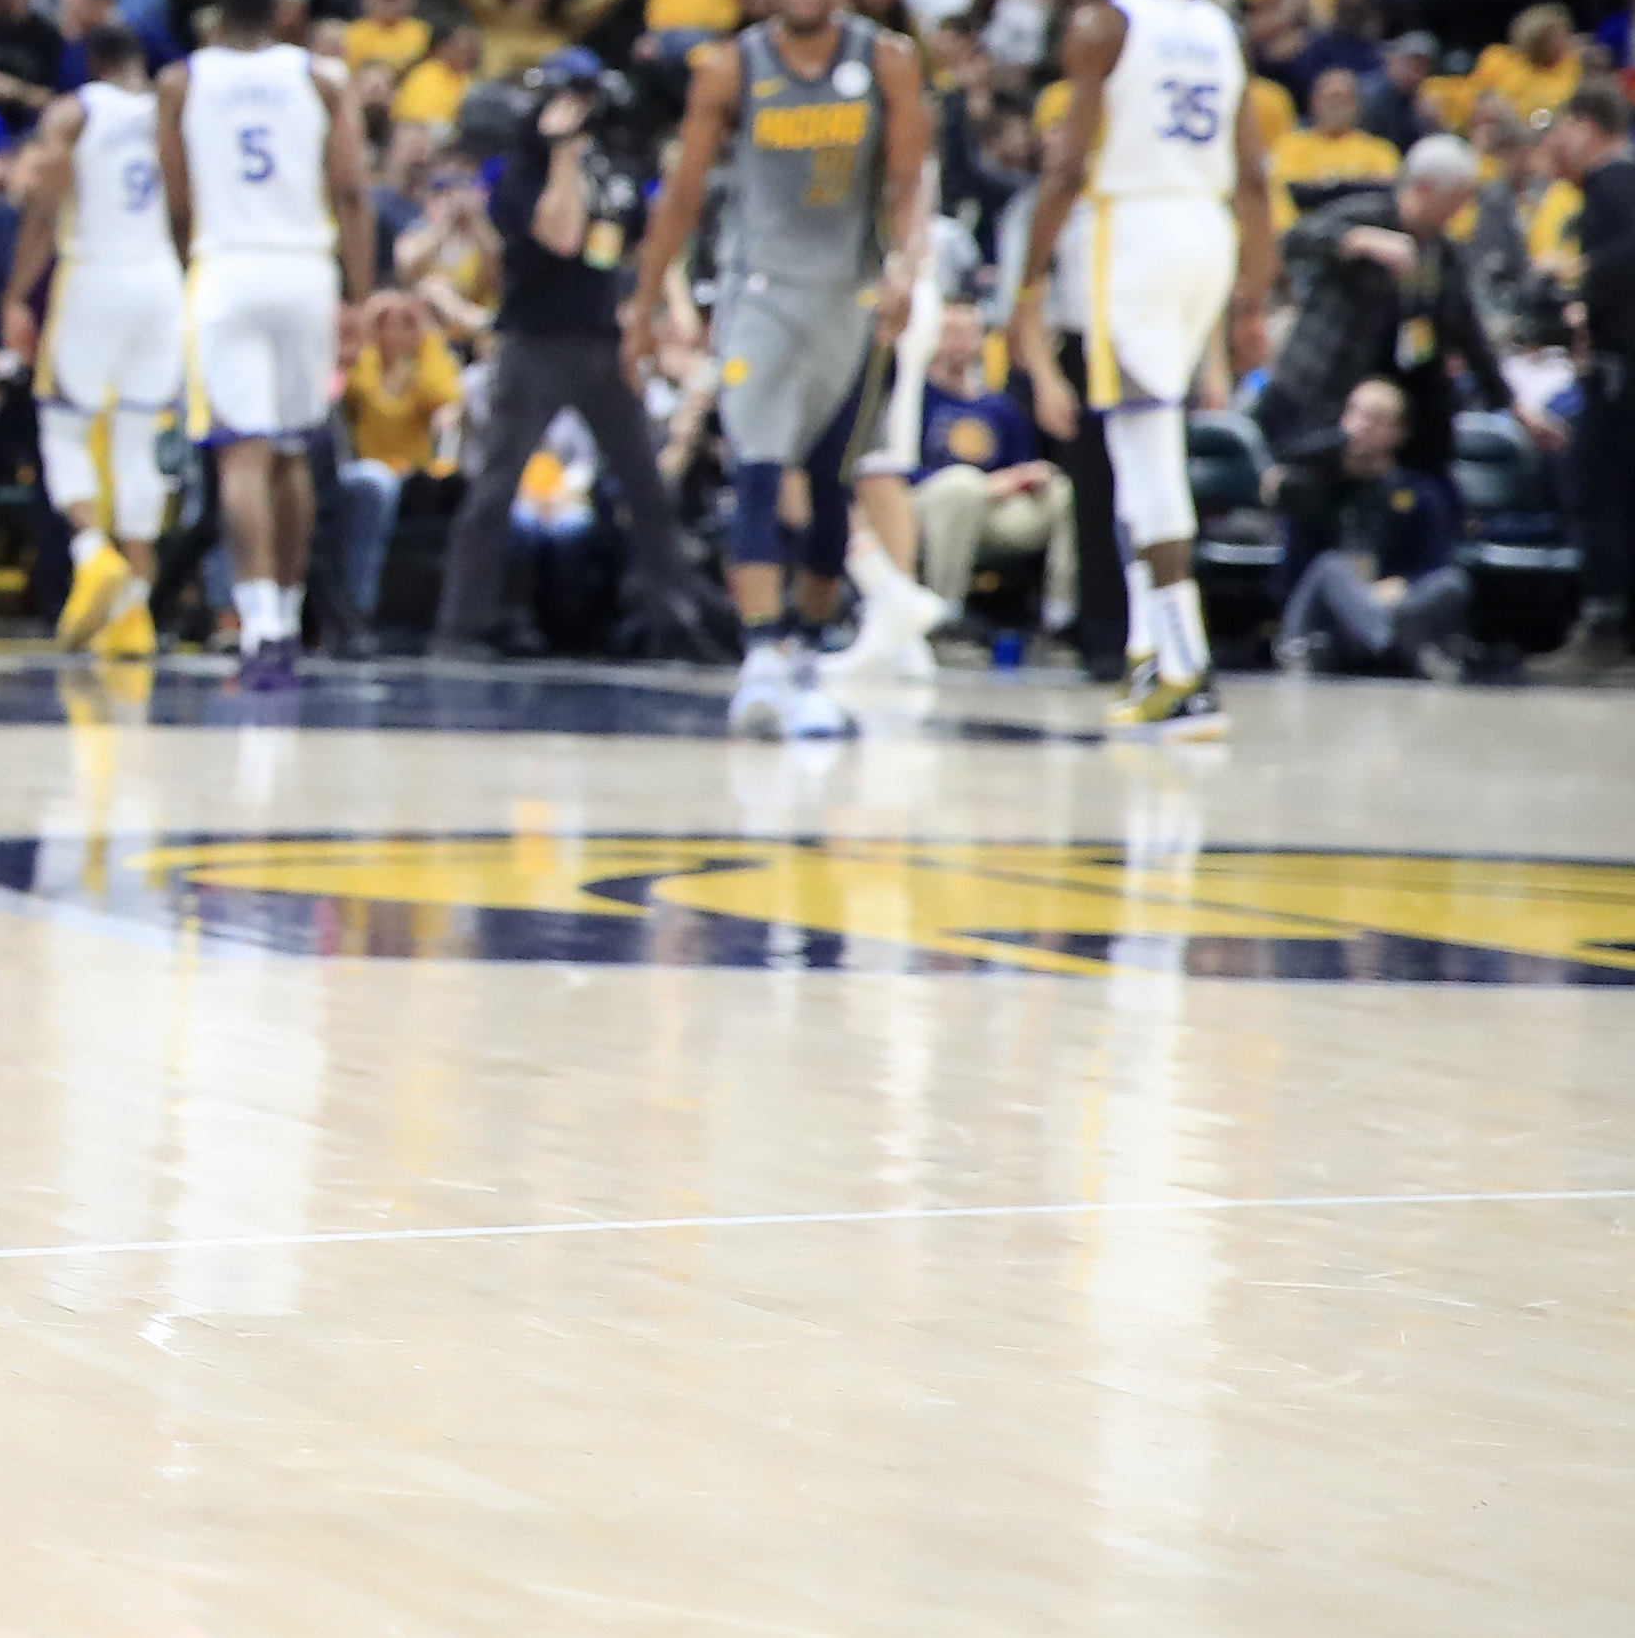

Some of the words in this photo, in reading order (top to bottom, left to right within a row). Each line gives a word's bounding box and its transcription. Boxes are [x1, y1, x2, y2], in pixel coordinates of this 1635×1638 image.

[1156, 77, 1219, 143] 35
[237, 125, 275, 184] 5
[120, 159, 155, 213] 9
